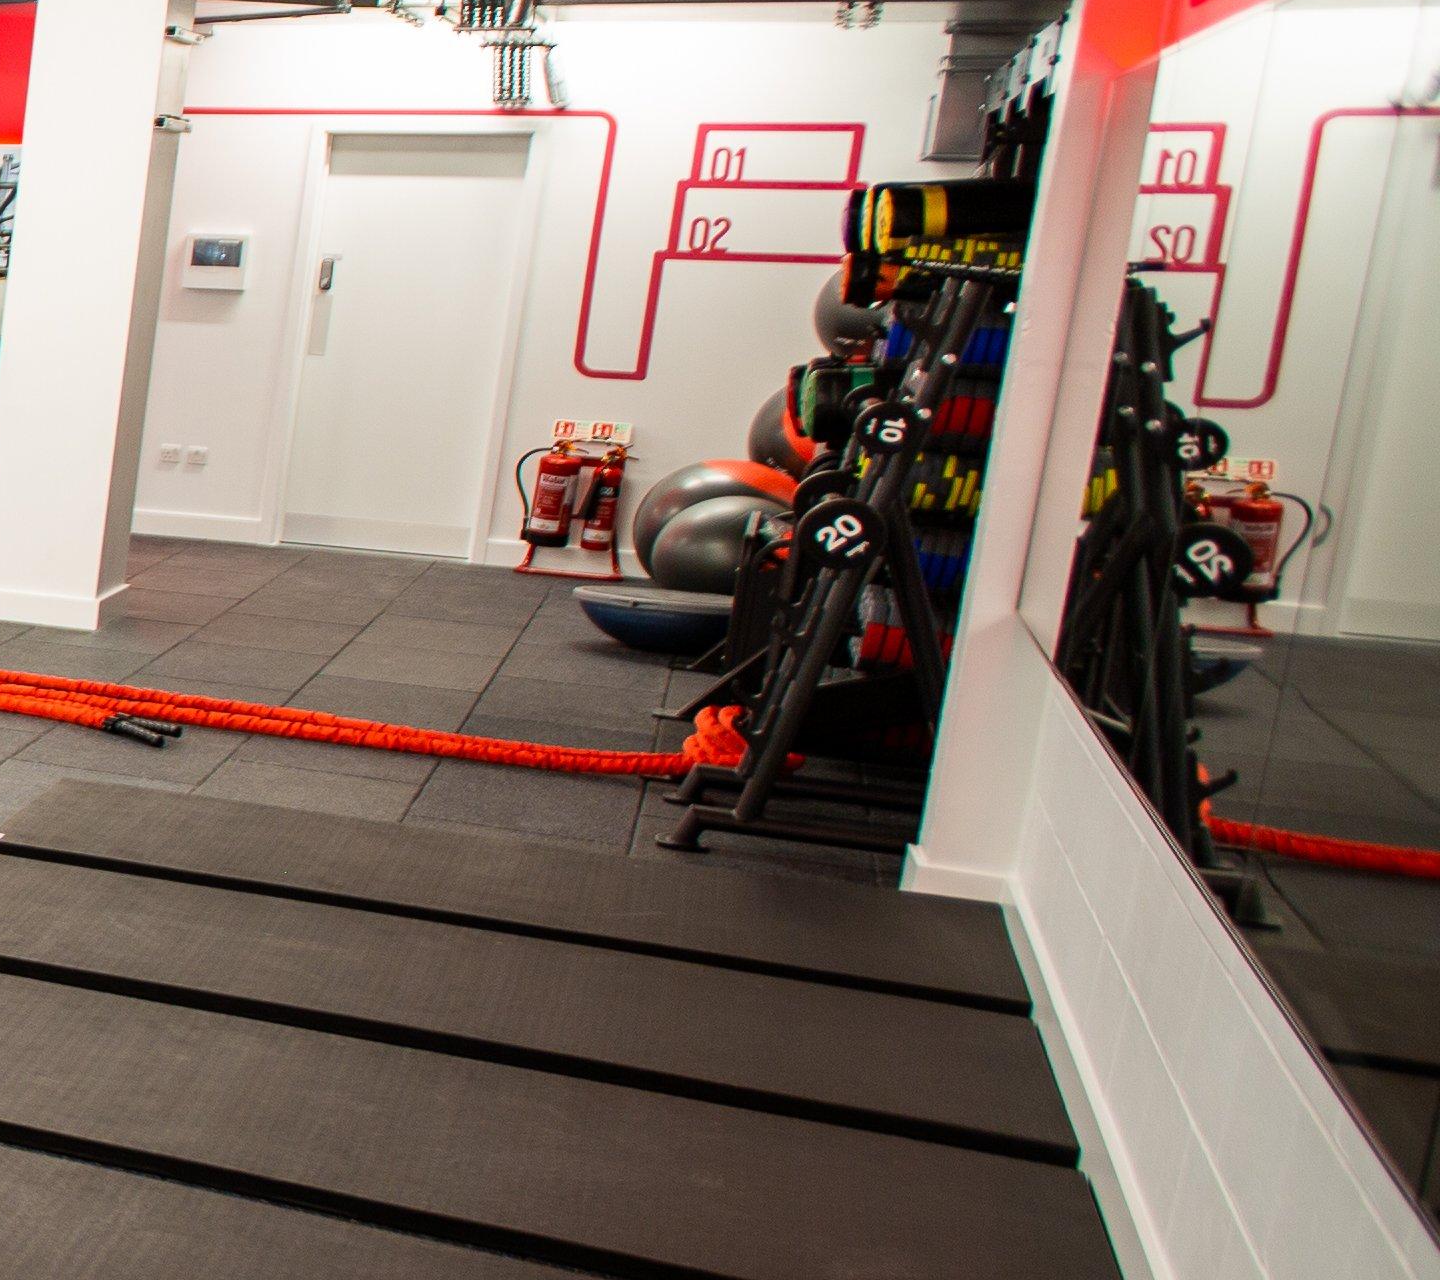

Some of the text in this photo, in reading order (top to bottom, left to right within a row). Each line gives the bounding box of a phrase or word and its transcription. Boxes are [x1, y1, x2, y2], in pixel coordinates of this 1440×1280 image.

[711, 147, 747, 182] 01
[689, 216, 732, 252] 02
[880, 418, 908, 443] 10
[815, 514, 862, 552] 20
